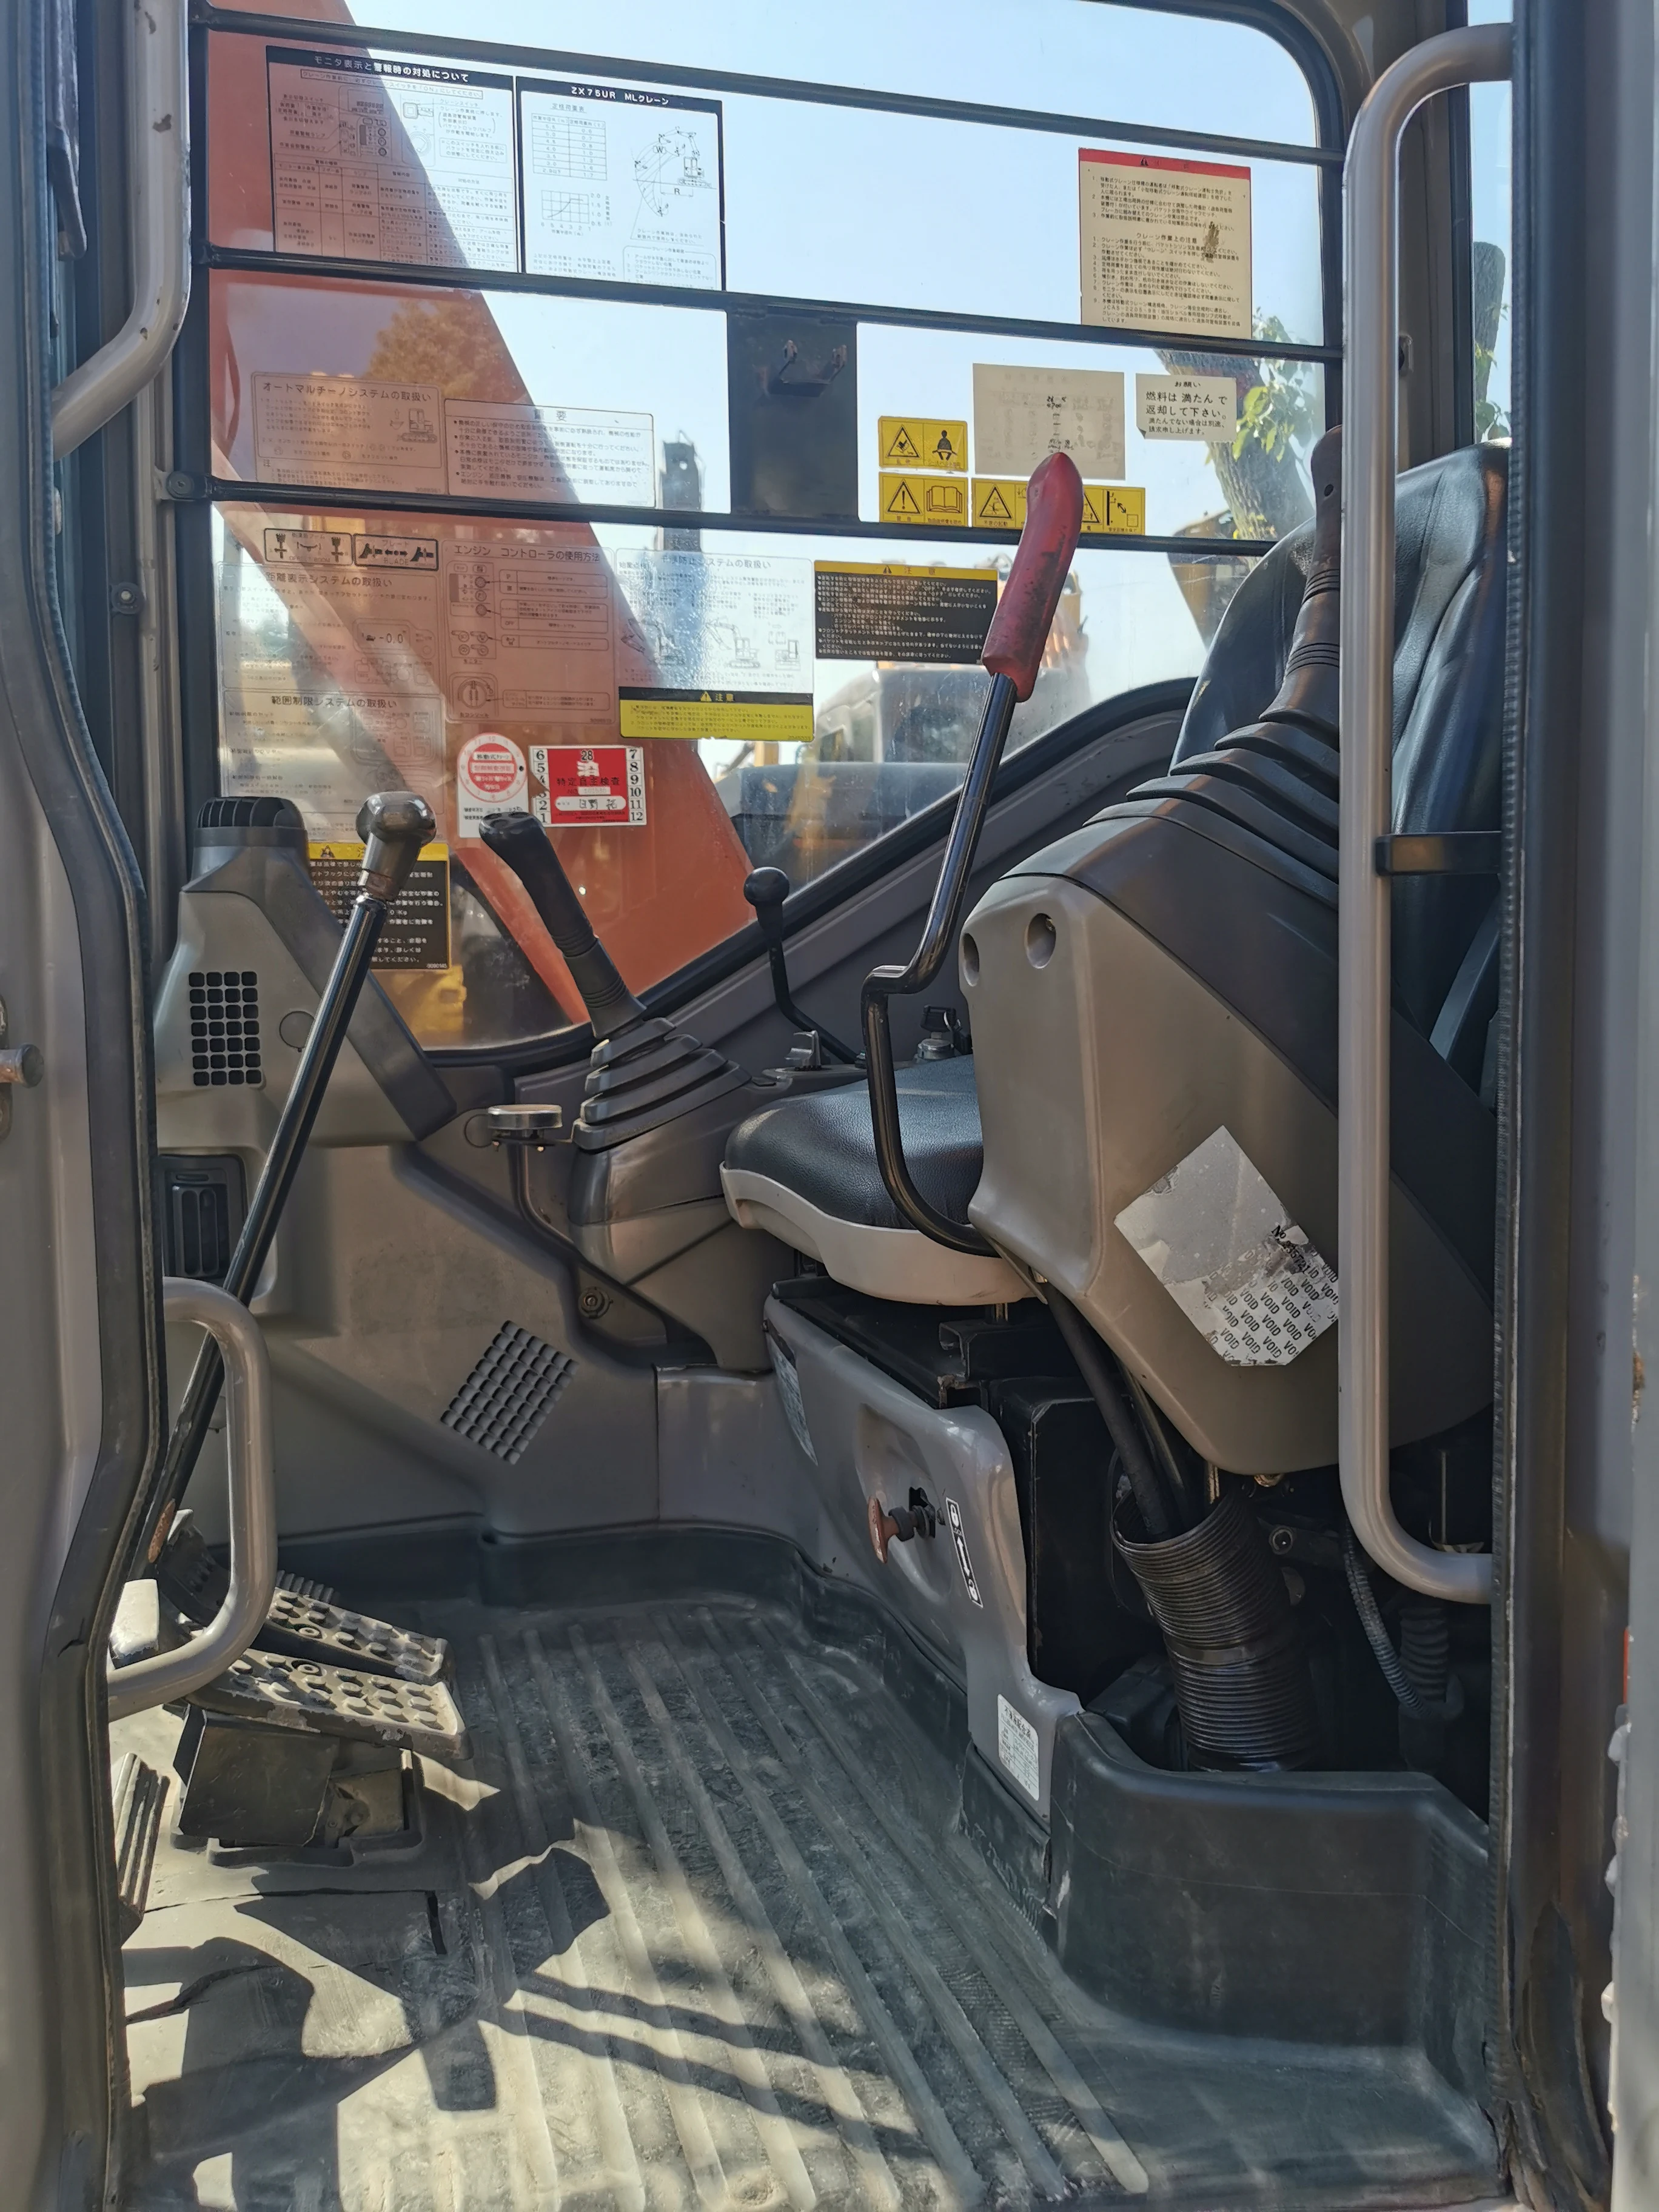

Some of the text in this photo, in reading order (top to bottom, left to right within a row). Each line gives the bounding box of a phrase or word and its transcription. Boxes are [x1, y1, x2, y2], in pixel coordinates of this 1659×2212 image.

[571, 86, 669, 106] ZX75UR MLクレーン
[1136, 233, 1197, 244] クレーン作業上の注意
[1146, 405, 1227, 420] 返却して下さい。
[455, 545, 600, 561] エンジン コントローラの使用方法
[383, 557, 409, 566] BLADE
[536, 750, 545, 760] 6
[580, 749, 594, 761] 28
[629, 749, 637, 759] 7
[537, 763, 546, 773] 5
[630, 762, 639, 773] 8
[557, 776, 620, 786] 特定自主検査
[631, 774, 638, 785] 9
[631, 787, 642, 797] 10
[539, 800, 548, 811] 2
[631, 800, 641, 809] 11
[541, 813, 547, 823] 1
[632, 811, 643, 822] 12
[1281, 1275, 1299, 1296] VOID
[1300, 1278, 1319, 1301] VOID
[1240, 1288, 1259, 1310] VOID
[1260, 1292, 1280, 1315] VOID
[1281, 1296, 1301, 1319] VOID
[1241, 1310, 1260, 1332] VOID
[1262, 1314, 1281, 1336] VOID
[1283, 1318, 1302, 1341] VOID
[1220, 1327, 1239, 1350] VOID
[1241, 1332, 1261, 1354] VOID
[1262, 1336, 1282, 1358] VOID
